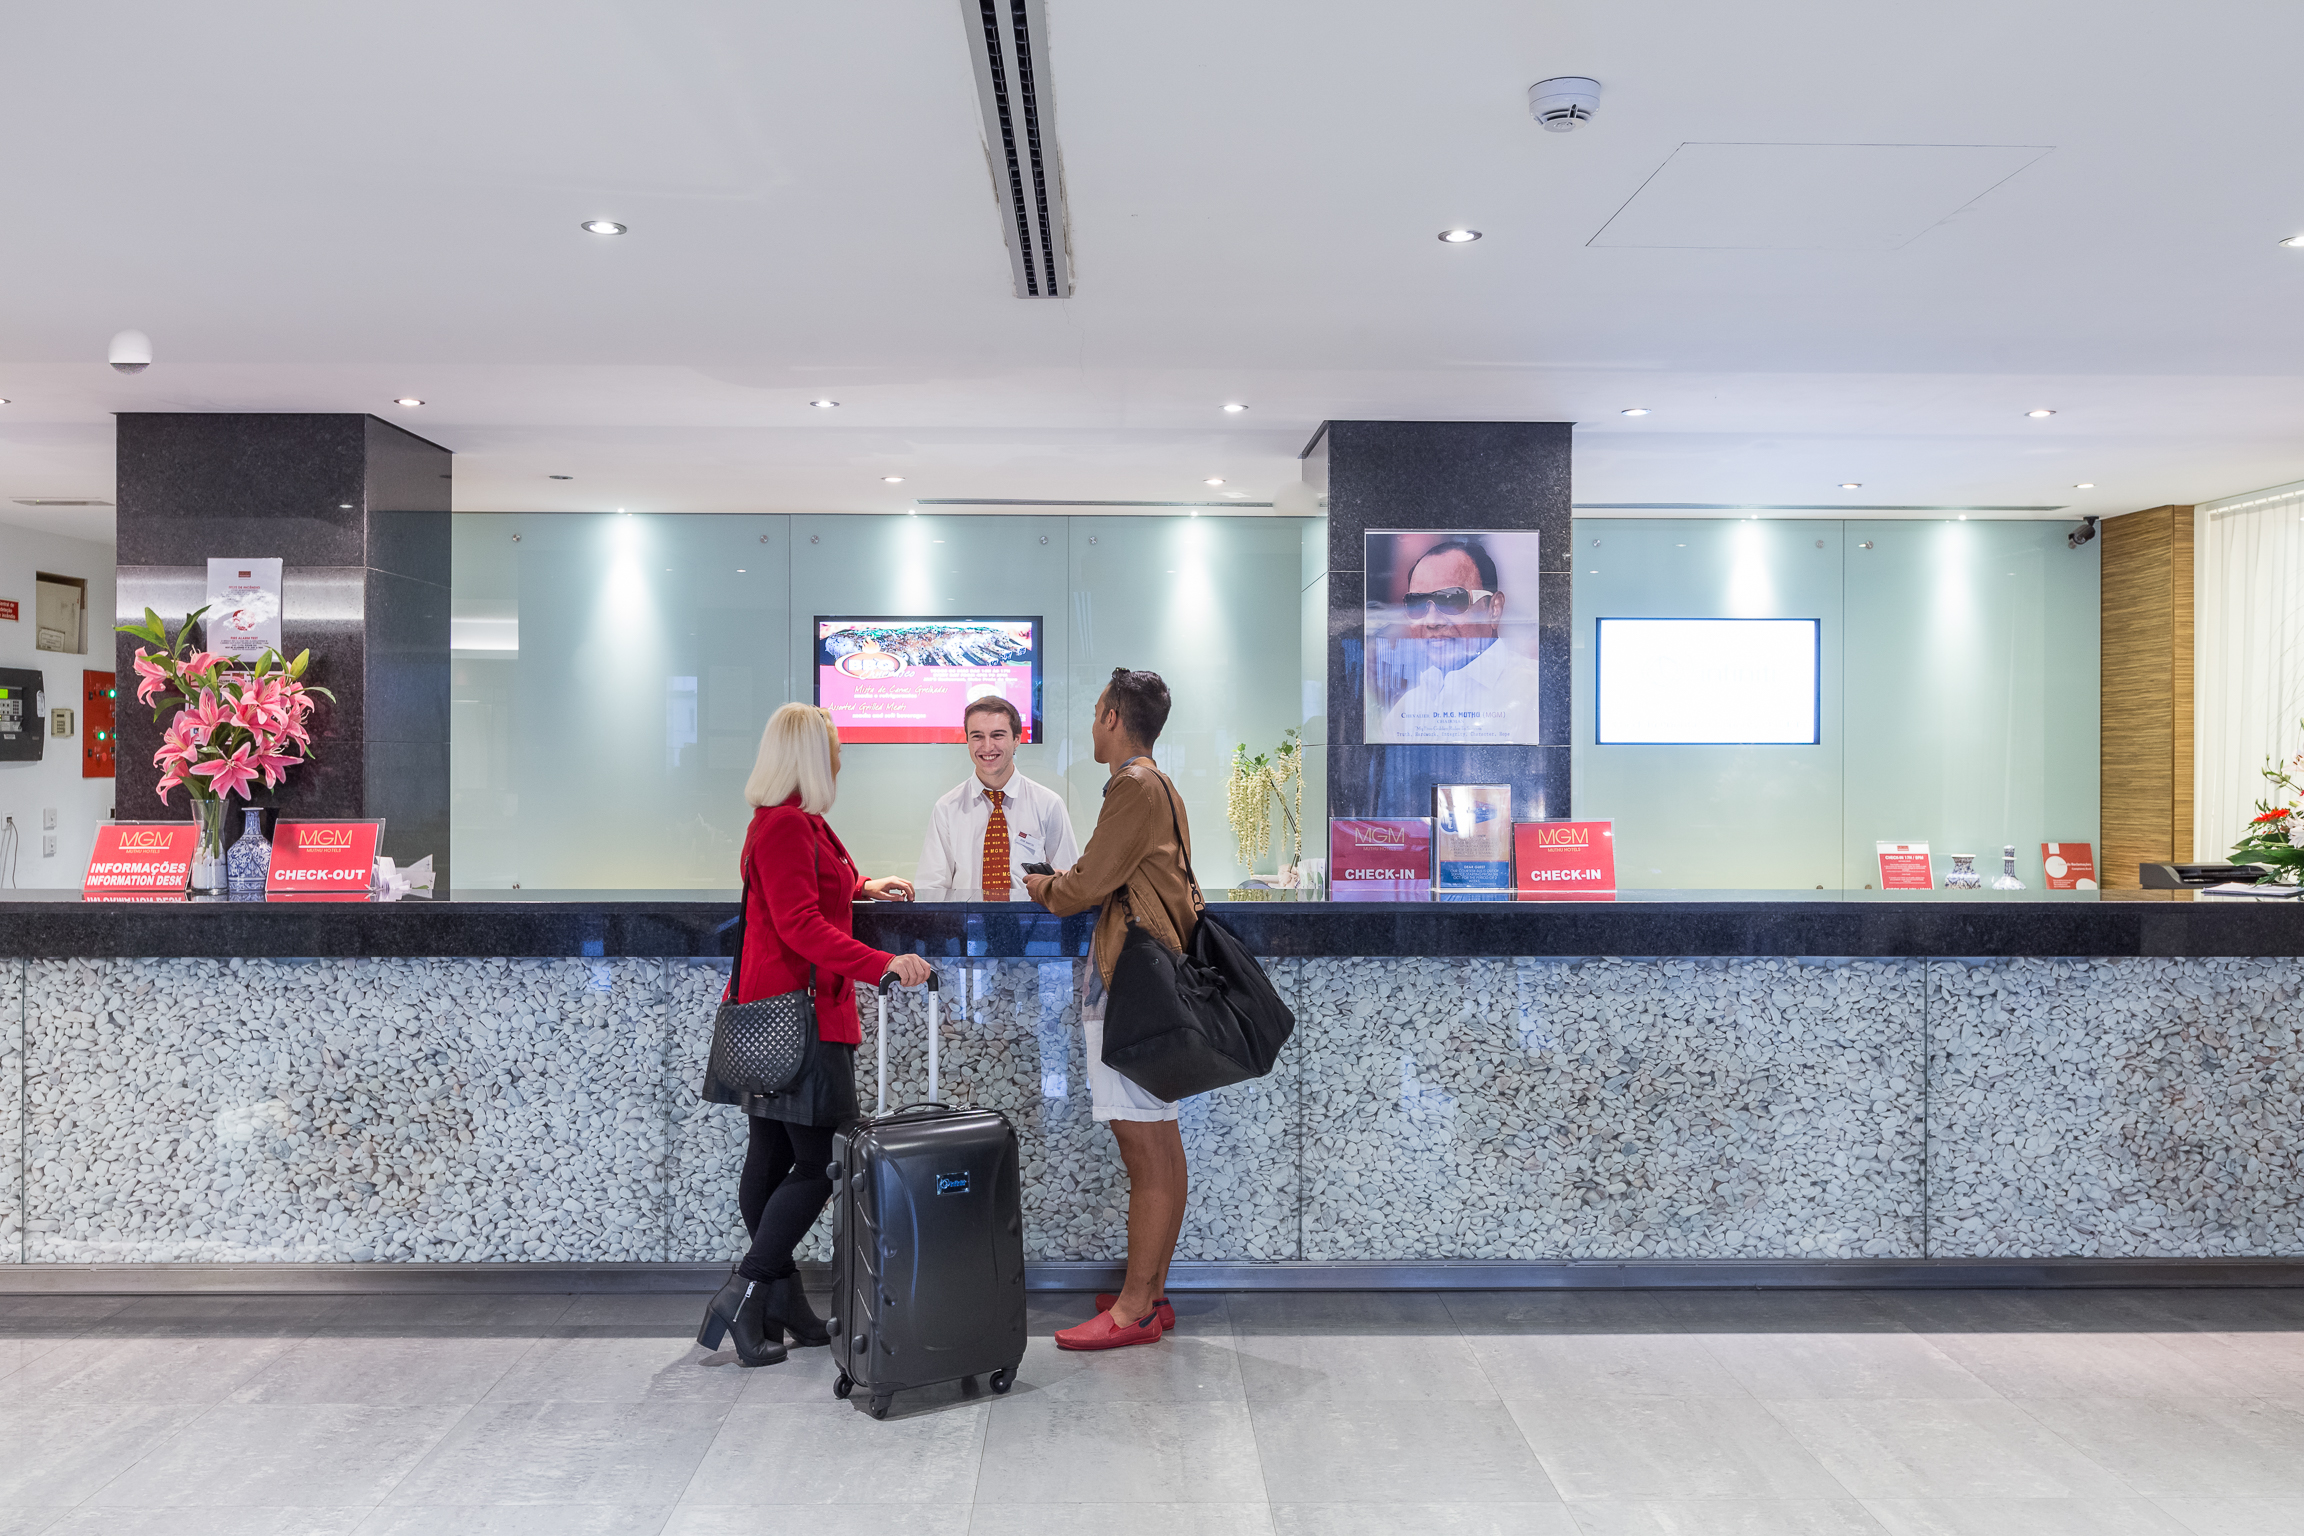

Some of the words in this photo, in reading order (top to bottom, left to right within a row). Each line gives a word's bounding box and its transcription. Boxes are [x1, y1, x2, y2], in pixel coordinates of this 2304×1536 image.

[878, 685, 886, 693] de
[828, 702, 856, 711] Assorted
[859, 702, 884, 713] Grilled
[886, 702, 907, 711] Meats
[120, 831, 173, 846] MGM
[299, 830, 353, 845] MGM
[1355, 828, 1405, 843] MGM
[1539, 828, 1589, 844] MGM
[90, 861, 186, 875] INFORMAÇÕES
[87, 876, 155, 885] INFORMATION
[156, 876, 183, 885] DESK
[275, 870, 366, 880] CHECK-OUT
[1345, 869, 1415, 880] CHECK-IN
[1531, 869, 1601, 881] CHECK-IN
